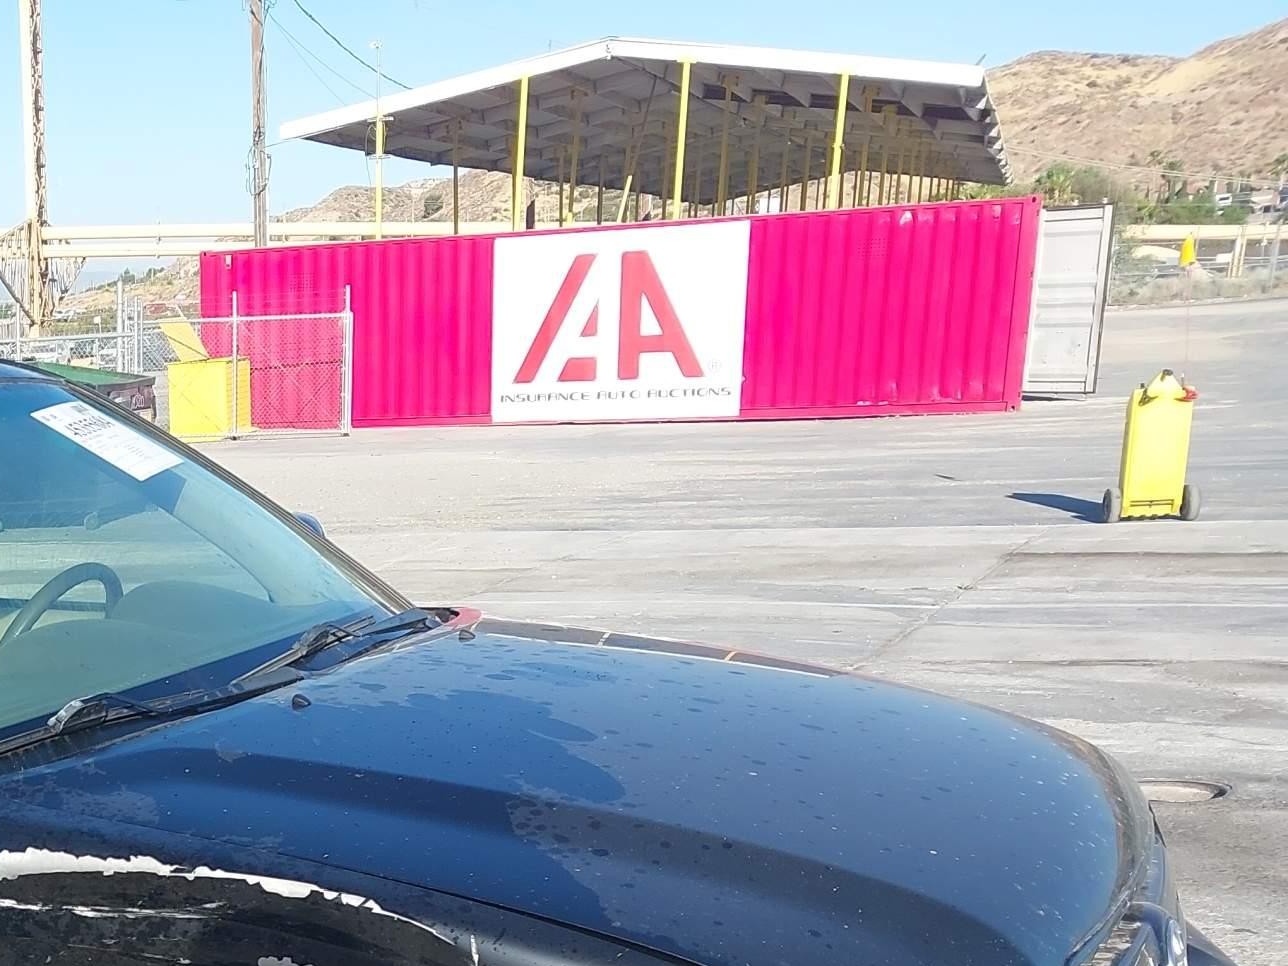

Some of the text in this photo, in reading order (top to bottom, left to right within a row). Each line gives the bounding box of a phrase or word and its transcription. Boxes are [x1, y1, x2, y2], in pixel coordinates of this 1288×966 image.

[500, 386, 732, 403] INSURANCE AUTO AUCTIONS
